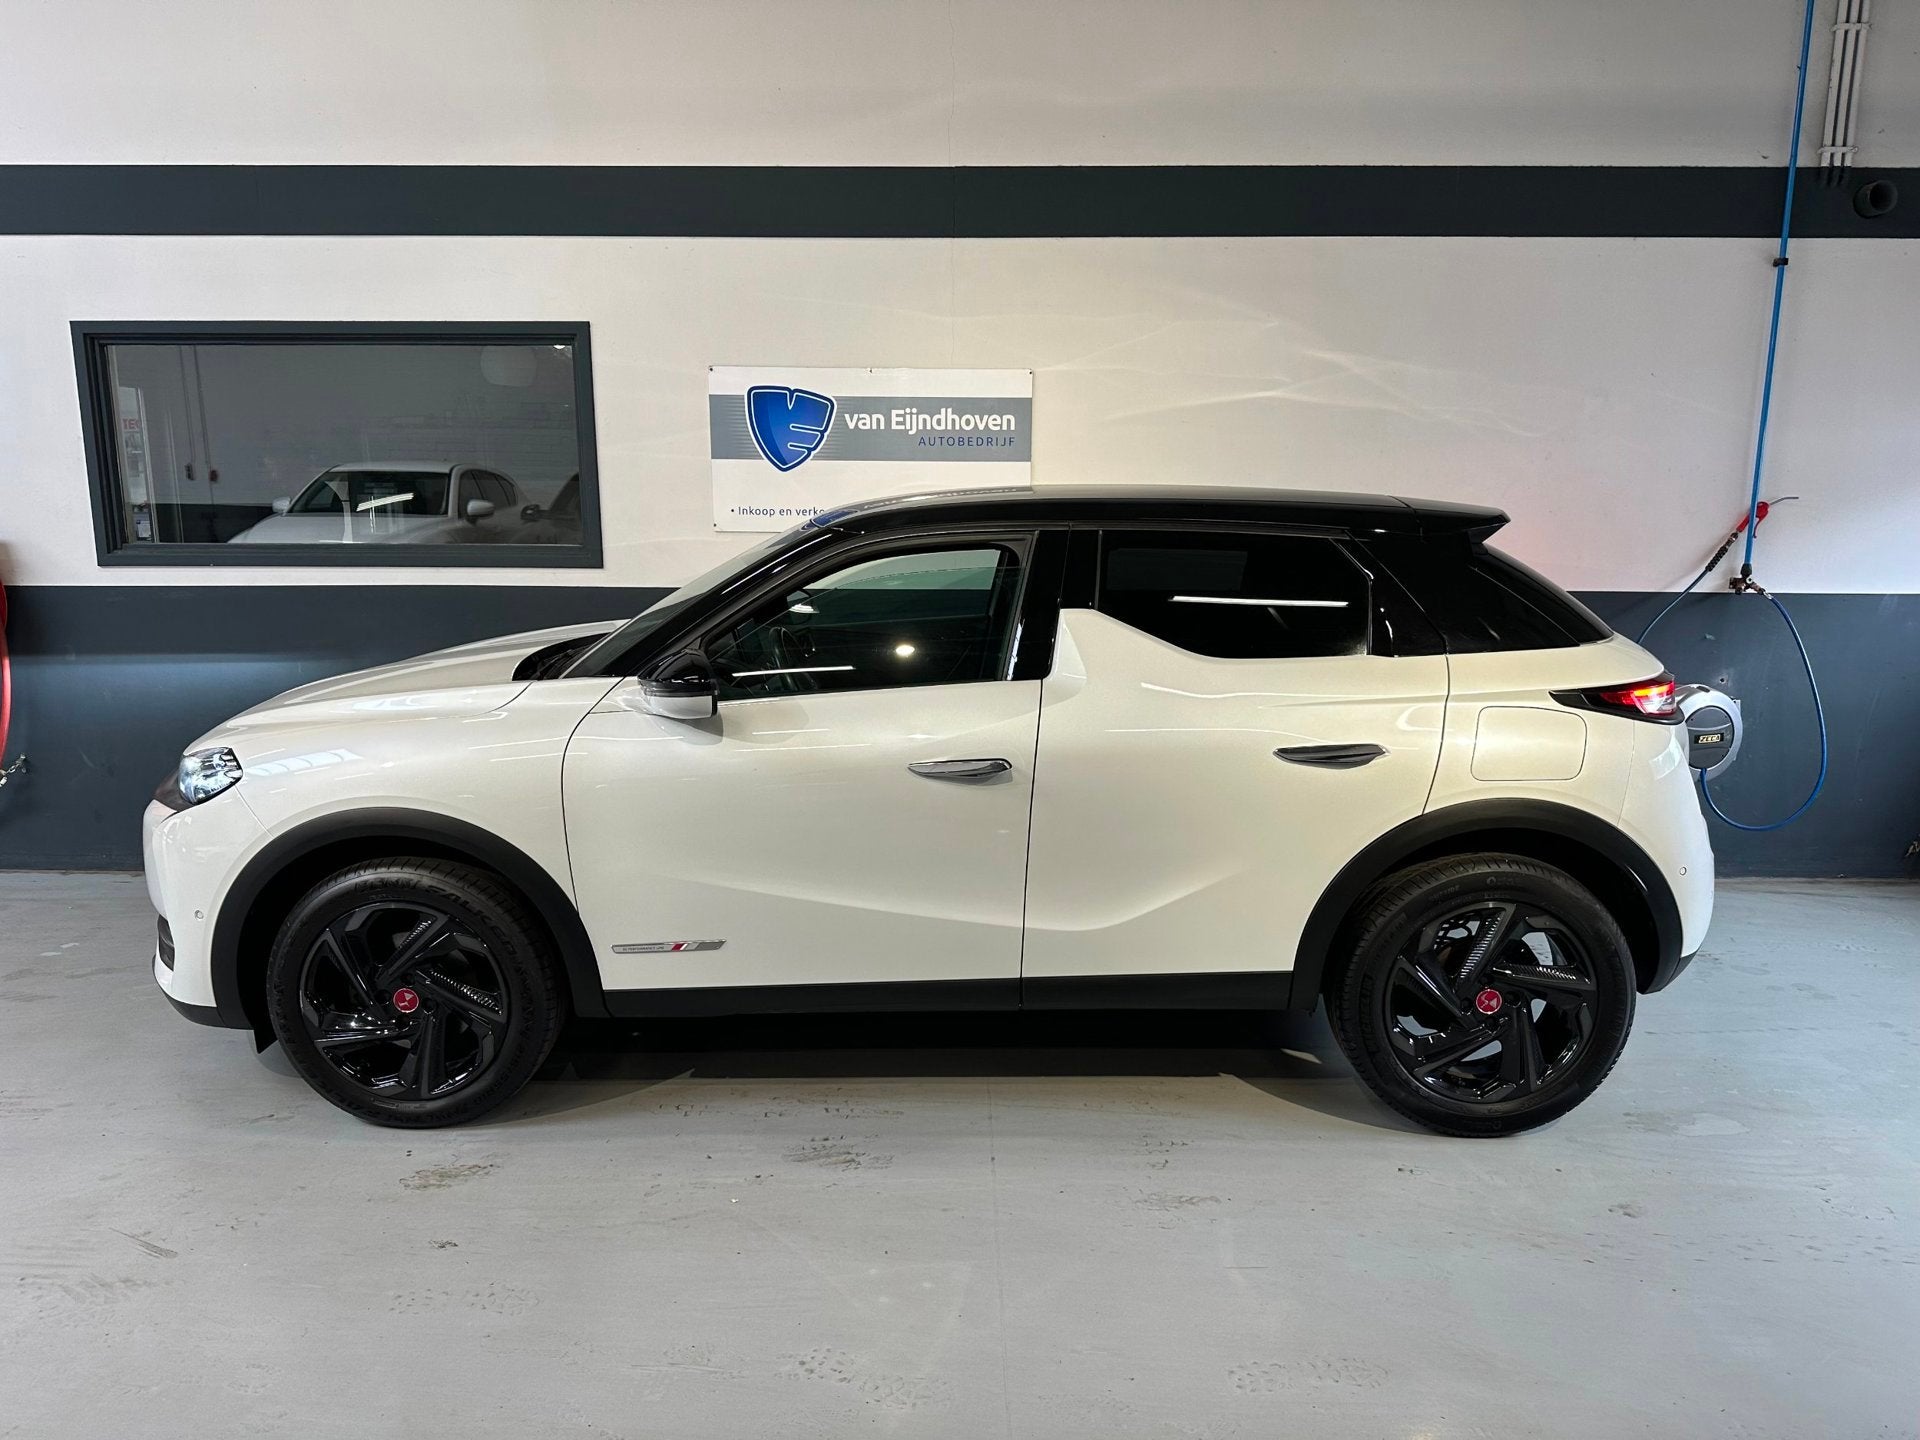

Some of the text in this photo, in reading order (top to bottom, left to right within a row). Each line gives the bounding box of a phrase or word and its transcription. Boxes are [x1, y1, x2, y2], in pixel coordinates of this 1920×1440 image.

[844, 407, 1016, 435] van Eijndhoven
[918, 436, 1016, 447] AUTOBEDRIJF
[738, 506, 775, 517] Inkoop
